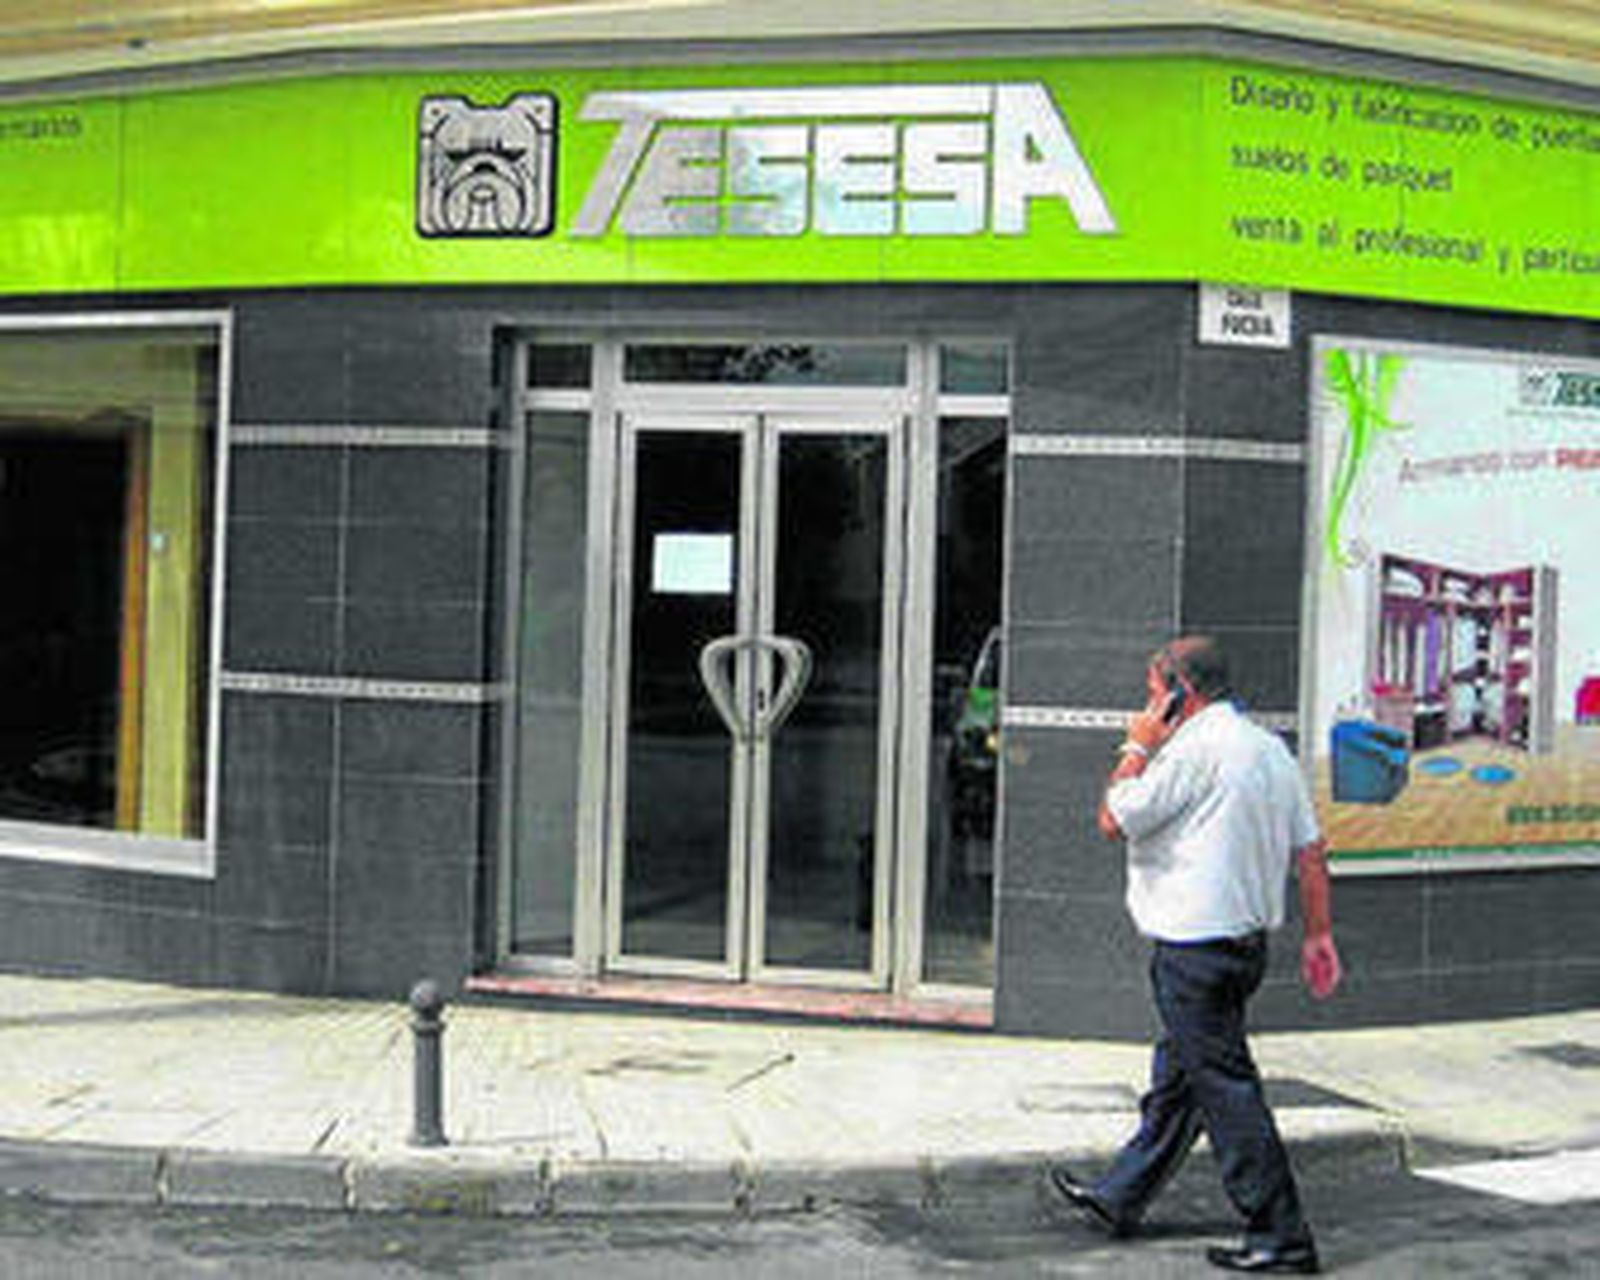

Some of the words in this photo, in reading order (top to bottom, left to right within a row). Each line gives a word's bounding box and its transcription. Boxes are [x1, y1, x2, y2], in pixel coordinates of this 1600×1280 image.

[1490, 112, 1521, 141] de
[565, 81, 1121, 237] TESESA
[1231, 146, 1310, 174] suelos
[1319, 153, 1348, 182] de
[1231, 214, 1303, 244] venta
[1317, 218, 1338, 247] al
[1354, 224, 1484, 262] profesional
